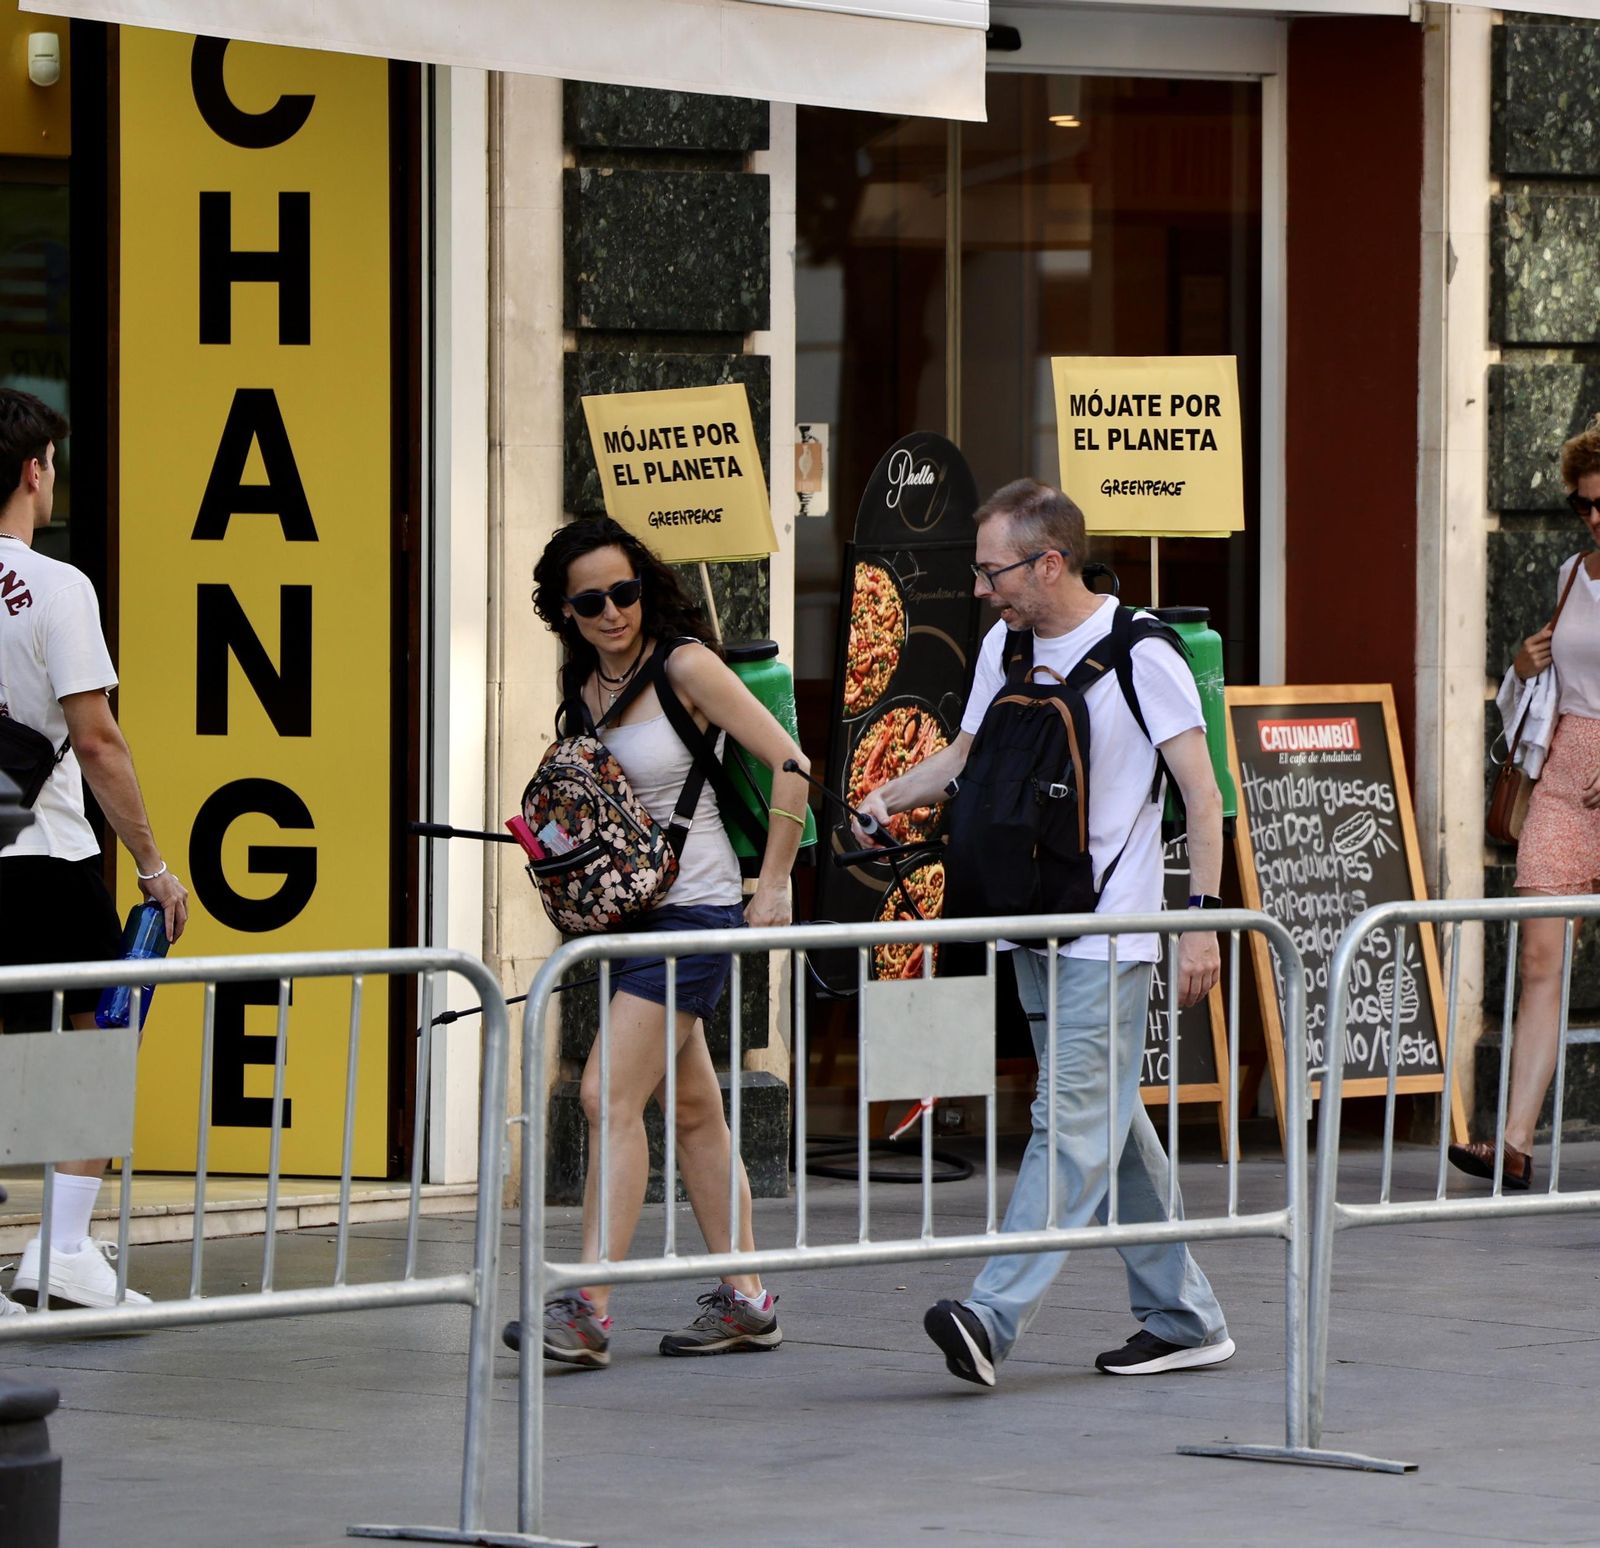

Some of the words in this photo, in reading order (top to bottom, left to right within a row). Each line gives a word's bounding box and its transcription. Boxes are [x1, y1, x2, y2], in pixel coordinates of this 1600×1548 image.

[1069, 389, 1162, 417] MÓJATE
[1170, 394, 1221, 417] POR
[603, 425, 688, 454] MÓJATE
[693, 422, 740, 447] POR
[1074, 428, 1099, 451] EL
[1107, 428, 1218, 451] PLANETA
[612, 463, 640, 486] EL
[643, 455, 743, 484] PLANETA
[886, 449, 935, 509] Paella
[1100, 479, 1186, 498] GREENPEACE
[648, 507, 723, 530] GREENPEACE
[0, 562, 33, 616] NE
[189, 35, 319, 1128] CHANGE
[1261, 721, 1354, 750] CATUNAMBÚ
[1279, 752, 1288, 764] El
[1308, 752, 1319, 763] de
[1242, 762, 1395, 815] Hamburguesas
[1250, 812, 1283, 851] Hot
[1284, 812, 1324, 852] Dog
[1255, 843, 1372, 890] Sandwiches
